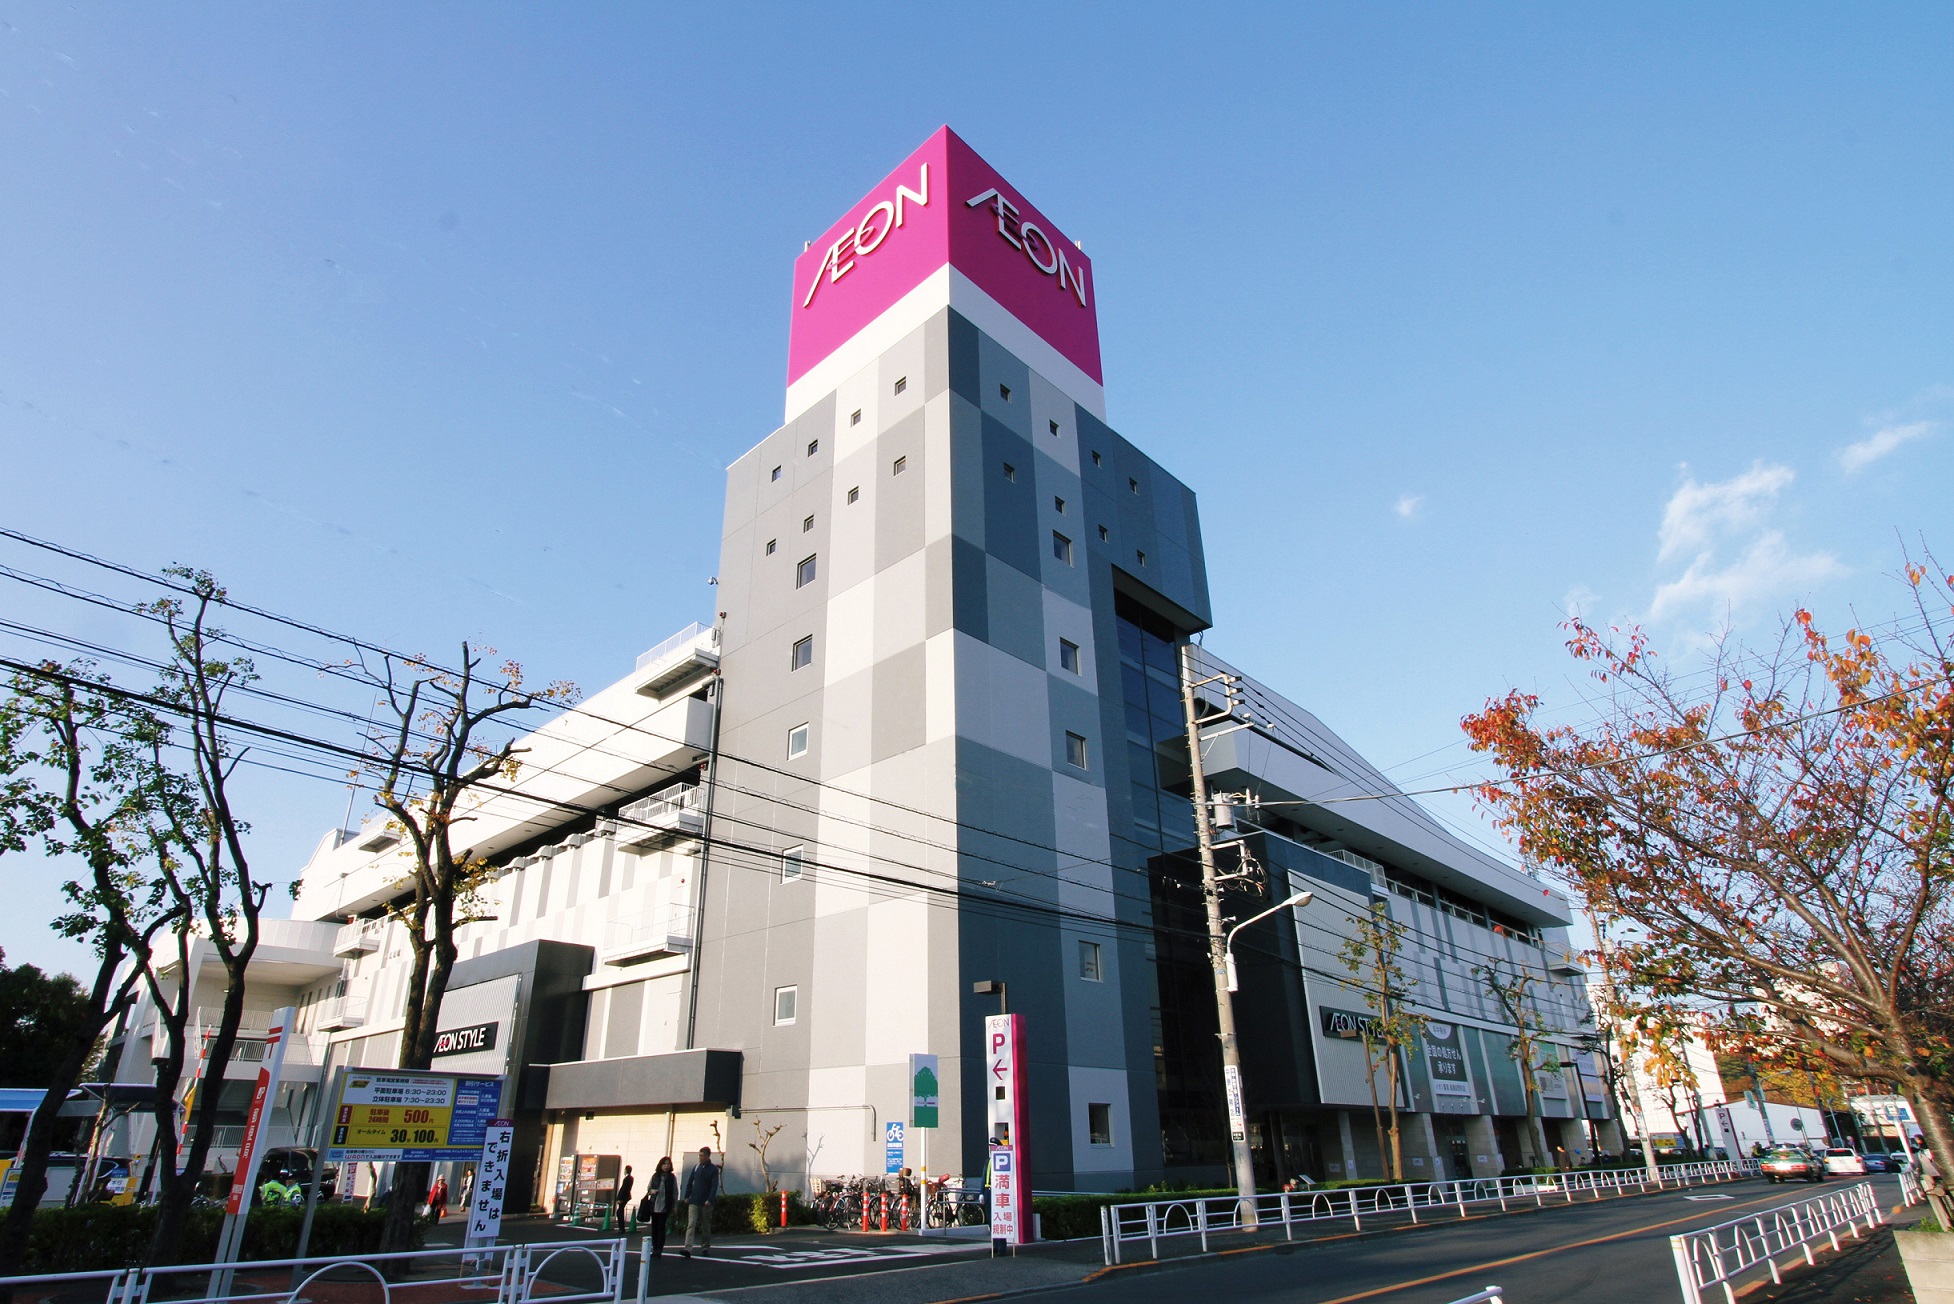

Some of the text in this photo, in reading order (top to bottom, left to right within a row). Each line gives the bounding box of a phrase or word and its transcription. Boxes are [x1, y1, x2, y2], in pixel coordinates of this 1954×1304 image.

[457, 1027, 486, 1050] STYLE
[993, 1033, 1005, 1054] P
[372, 1096, 402, 1104] 立体駐車場
[374, 1087, 403, 1095] 平面駐車場
[995, 1155, 1008, 1170] P
[488, 1131, 511, 1220] 右折入場は
[474, 1142, 498, 1232] できません
[995, 1174, 1010, 1208] 満車
[993, 1211, 1012, 1222] 入場
[992, 1223, 1014, 1235] 規制中
